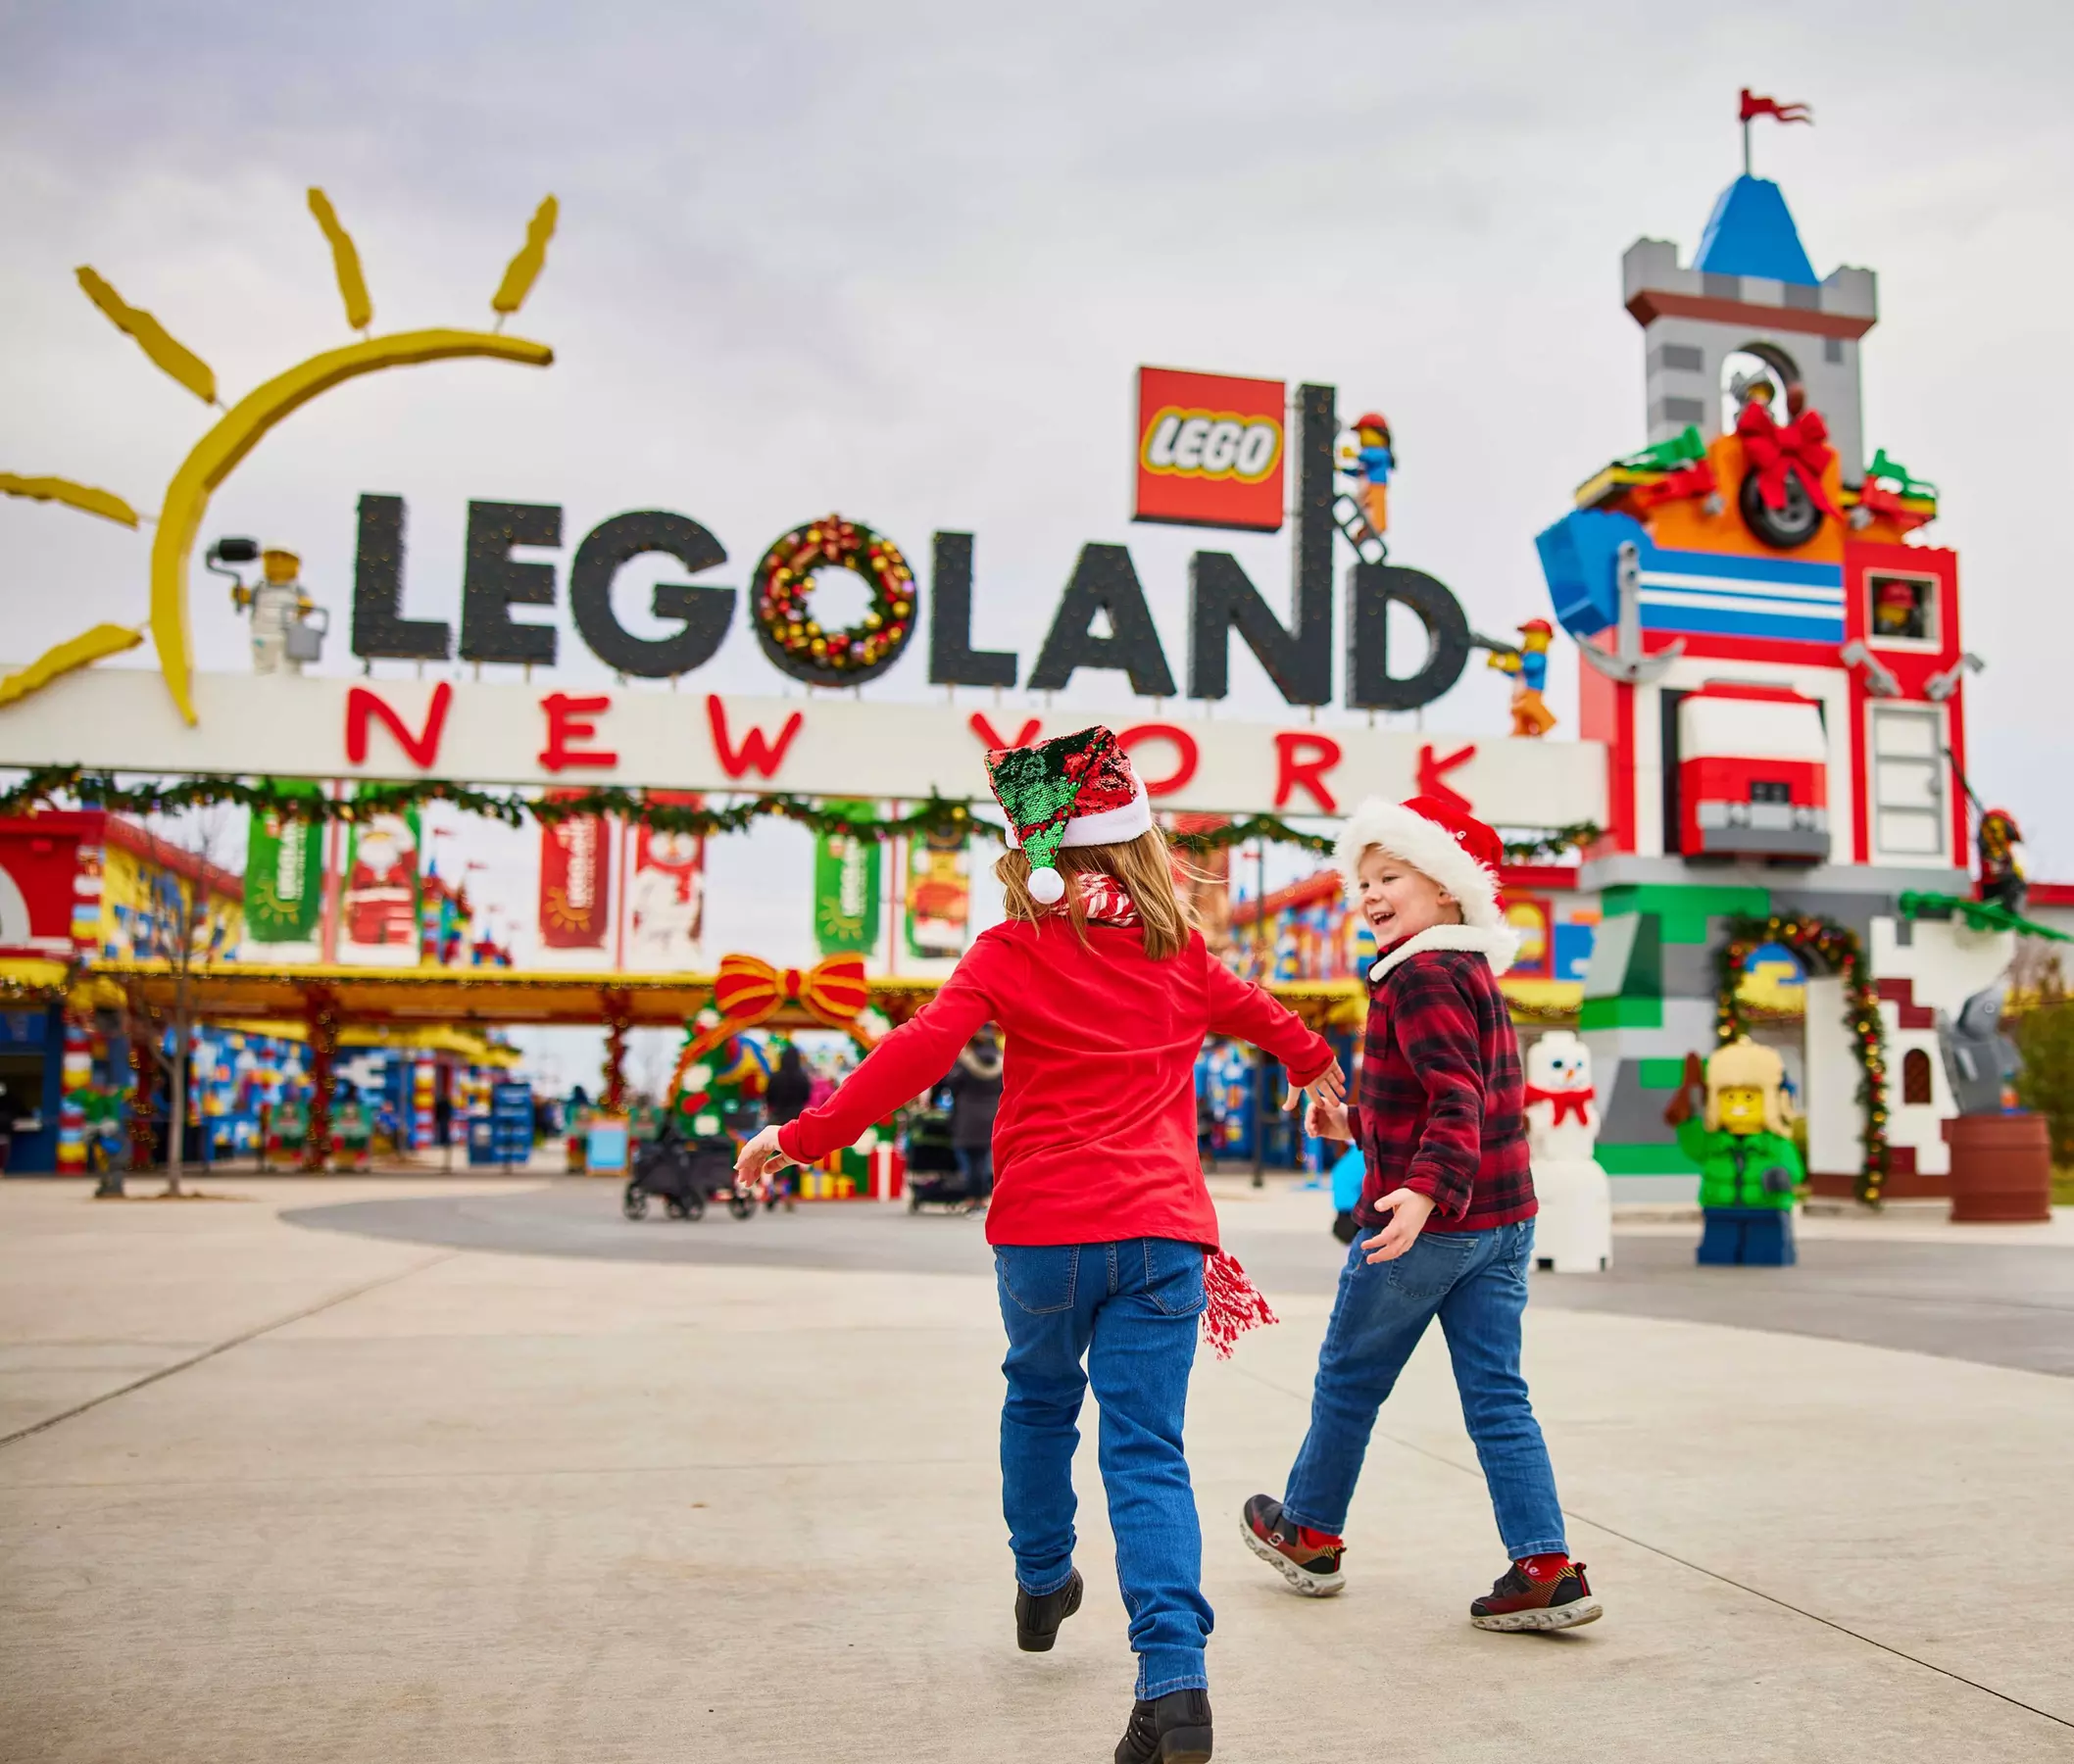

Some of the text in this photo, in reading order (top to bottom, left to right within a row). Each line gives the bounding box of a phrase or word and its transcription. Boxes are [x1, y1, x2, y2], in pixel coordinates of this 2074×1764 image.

[1150, 416, 1274, 475] LEGO
[351, 384, 1470, 710] LEGOLAND
[345, 682, 804, 778] NEW
